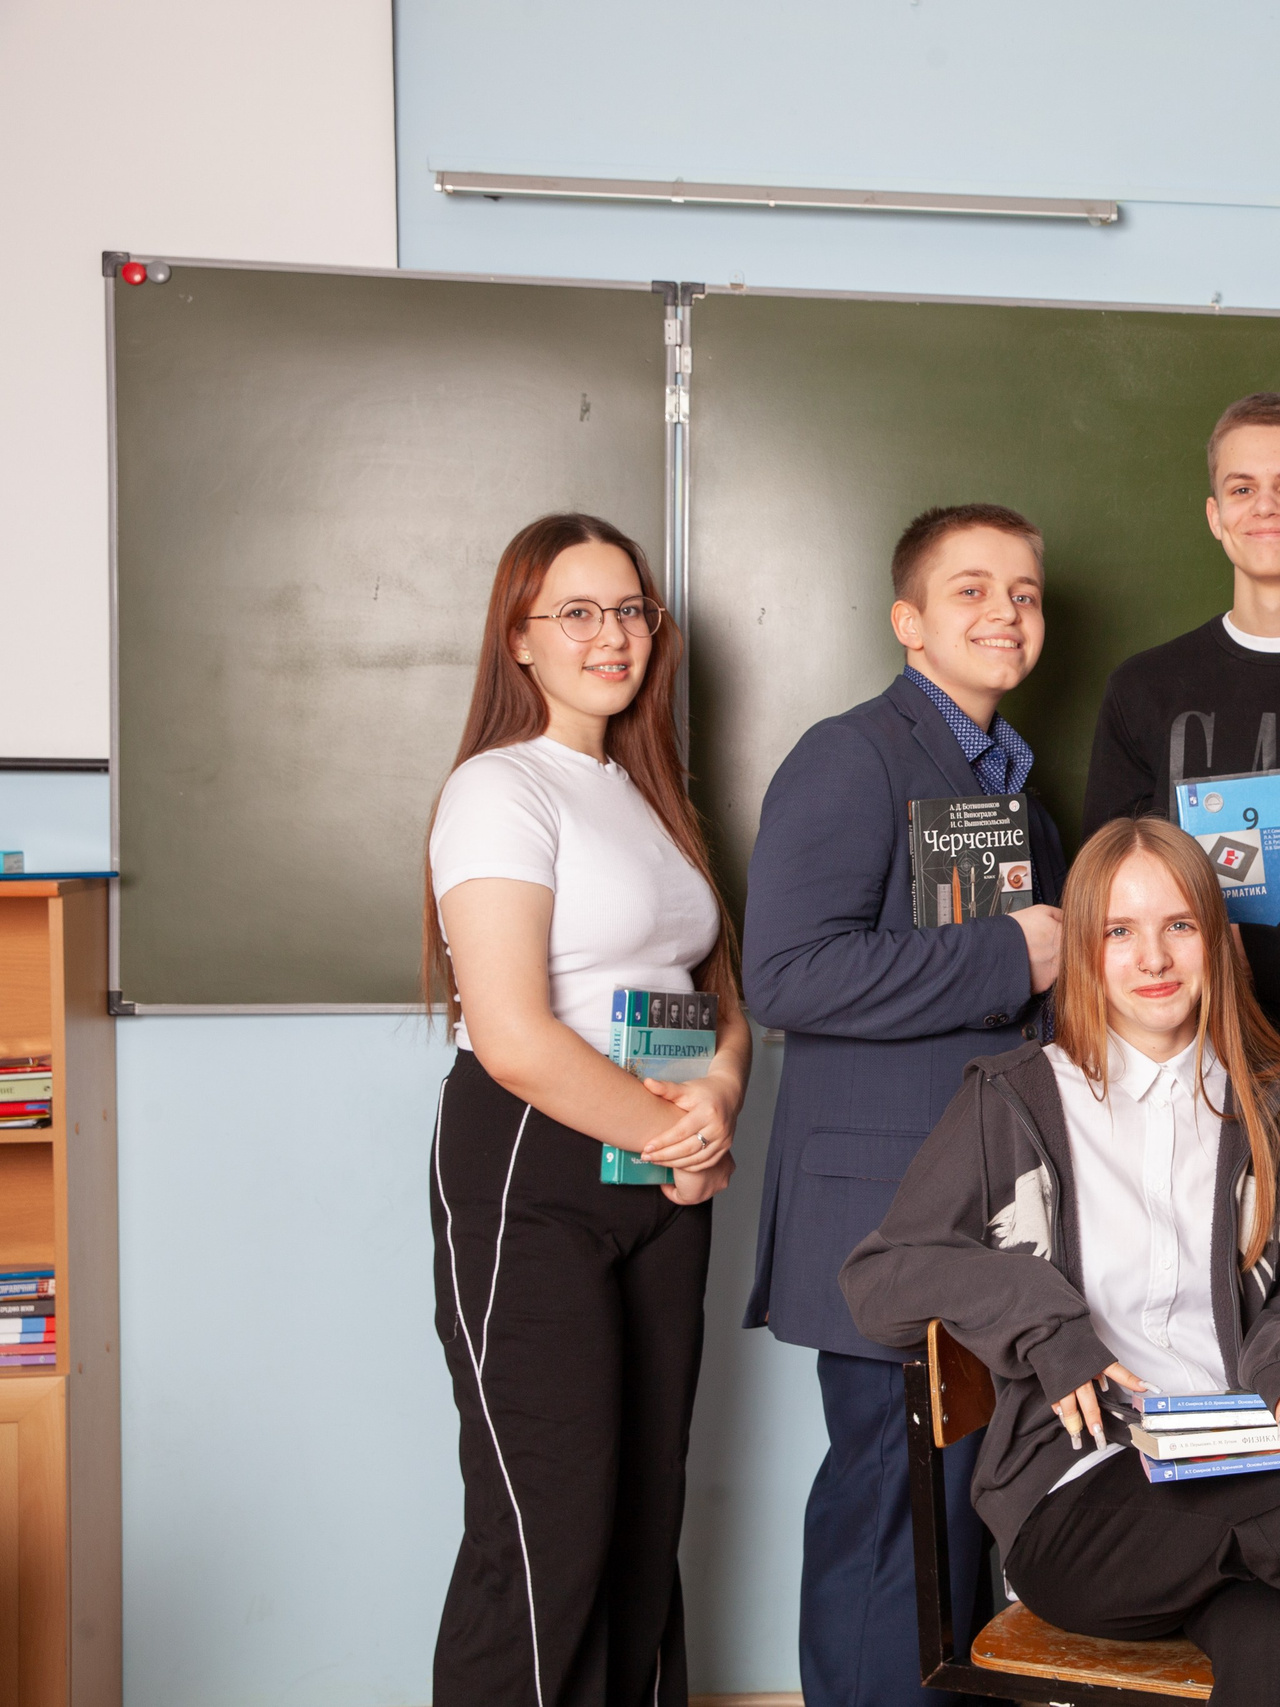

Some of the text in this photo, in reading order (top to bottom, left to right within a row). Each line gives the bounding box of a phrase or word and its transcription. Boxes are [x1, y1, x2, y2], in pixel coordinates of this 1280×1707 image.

[1242, 807, 1259, 830] 9
[923, 828, 1024, 857] Черчение
[982, 851, 996, 875] 9
[633, 1030, 709, 1057] ЛИТЕРАТУРА
[606, 1152, 614, 1163] 9
[1242, 1434, 1276, 1444] ФИЗИКА
